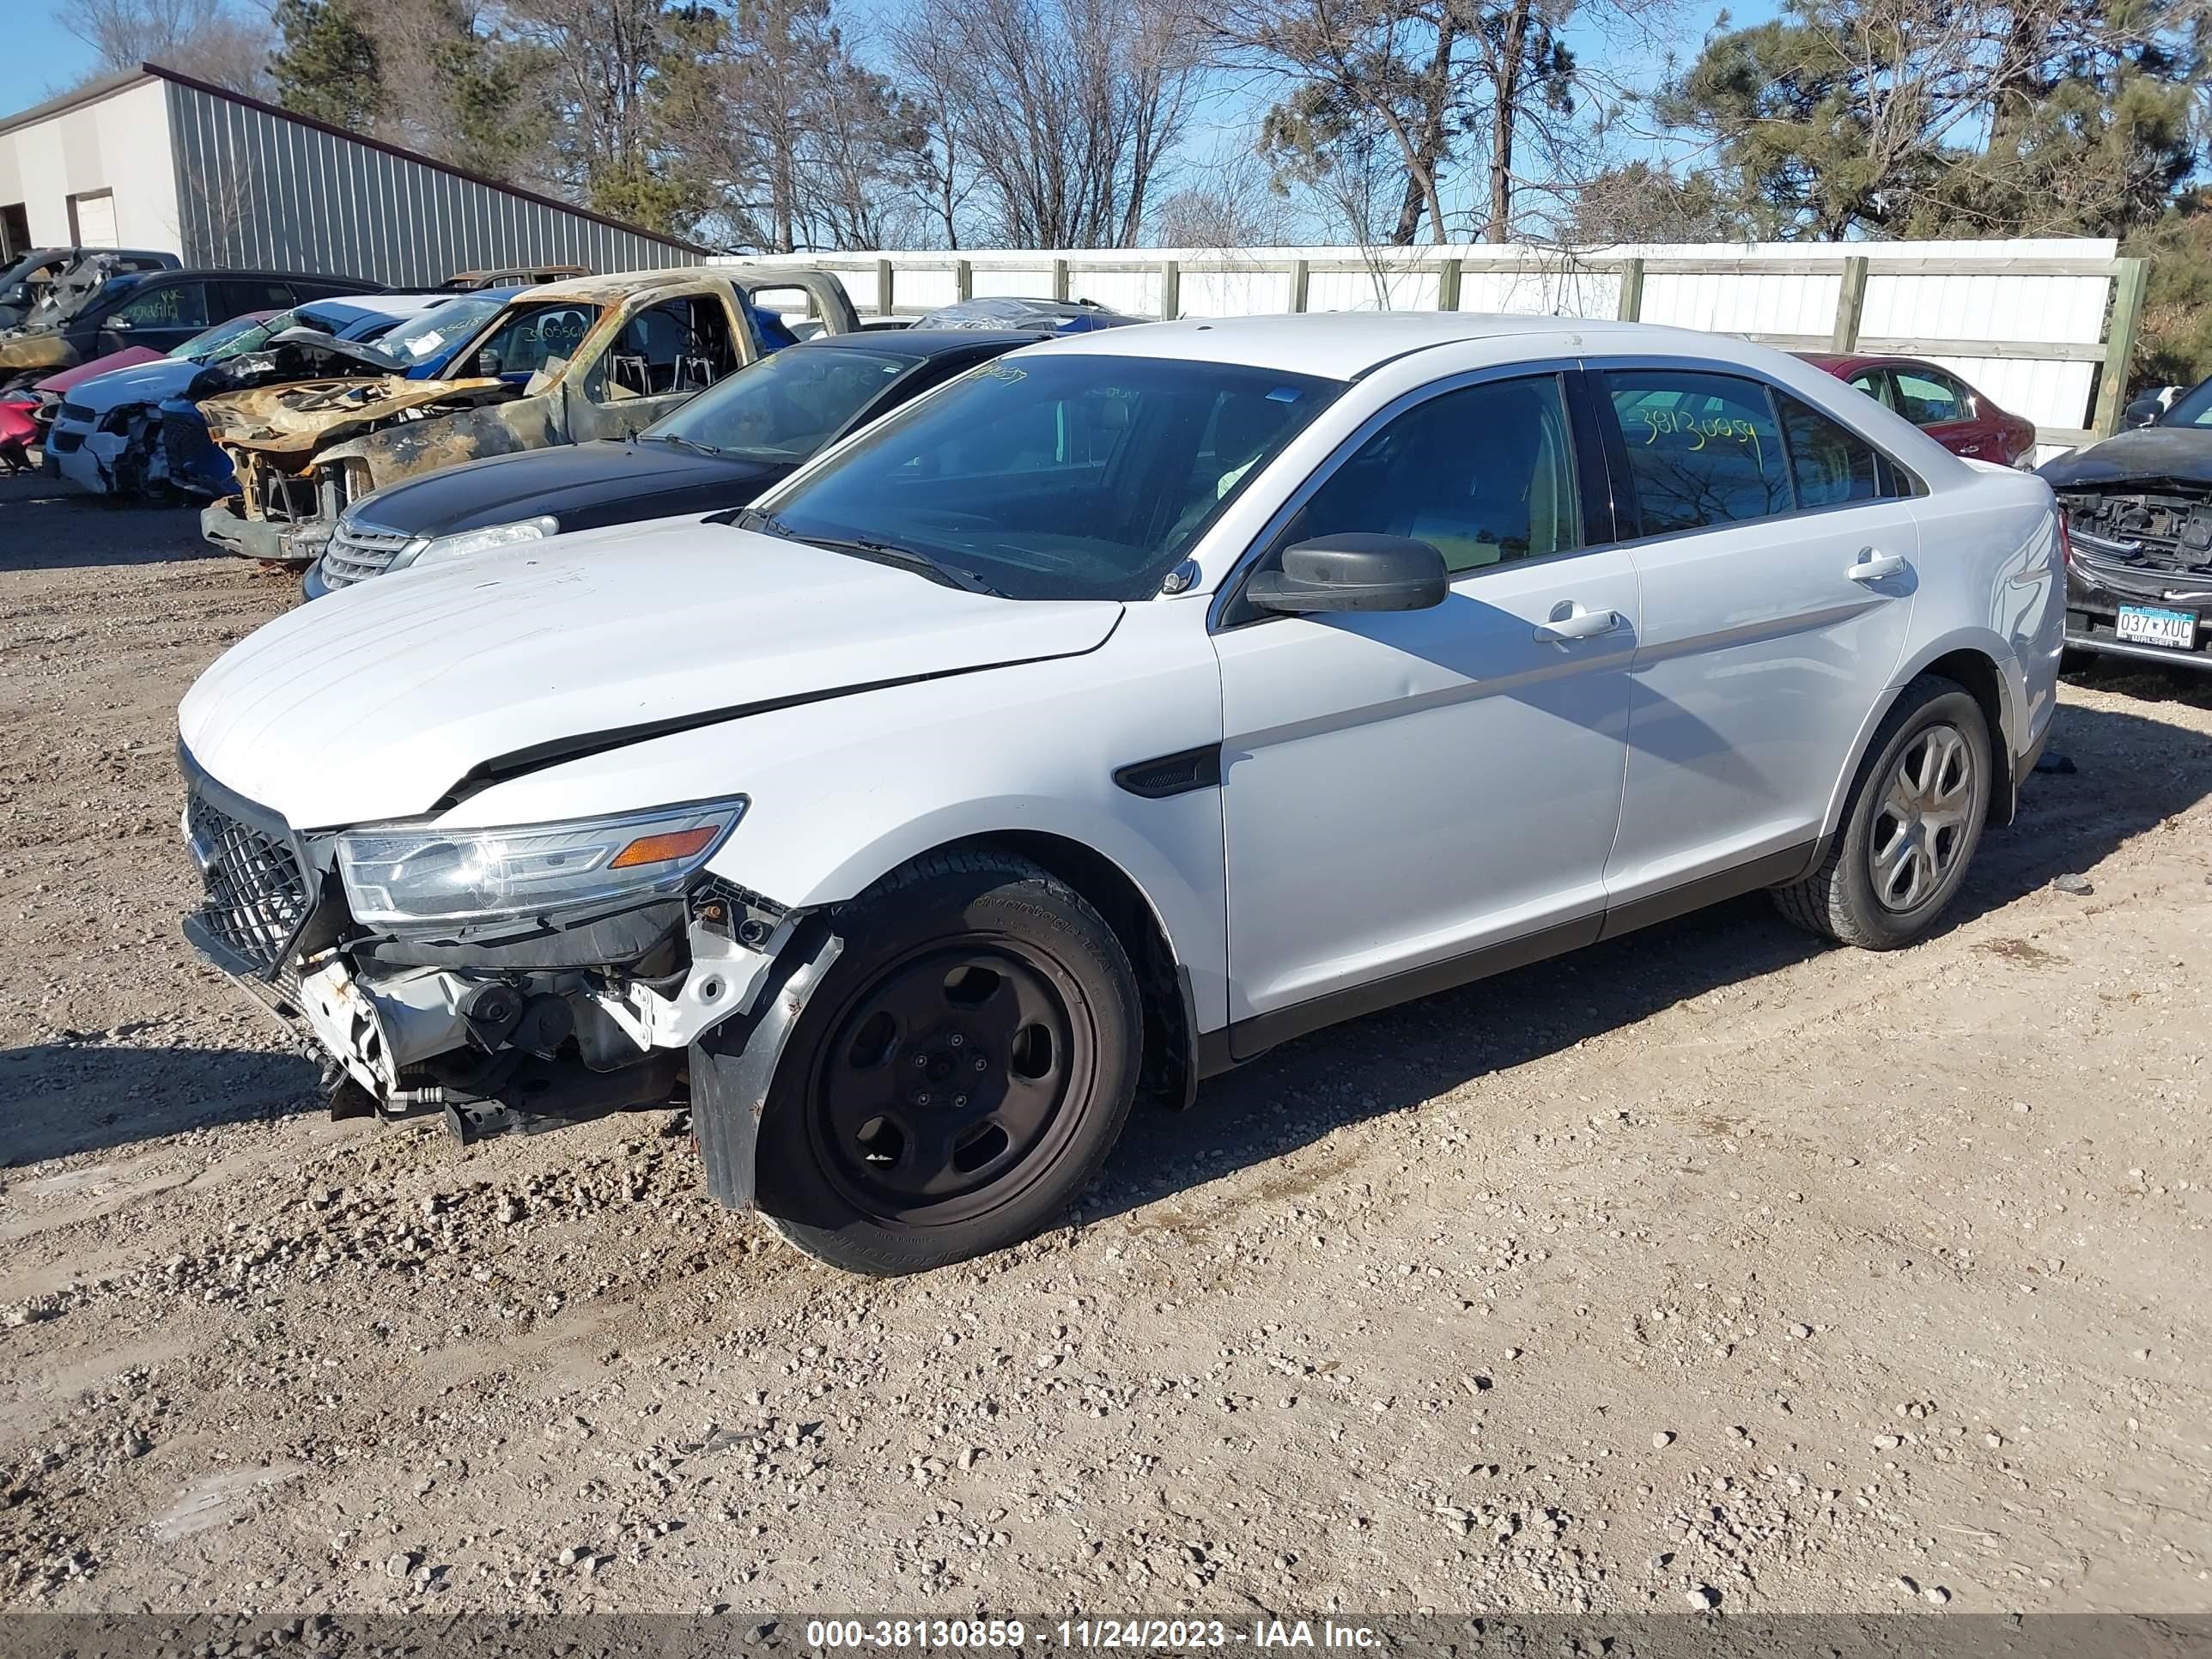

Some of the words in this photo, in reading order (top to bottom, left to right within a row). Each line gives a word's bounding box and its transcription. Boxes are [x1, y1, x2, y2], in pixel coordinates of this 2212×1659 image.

[2121, 614, 2150, 633] 037
[2161, 617, 2191, 638] XUC
[2131, 635, 2173, 647] WALSER
